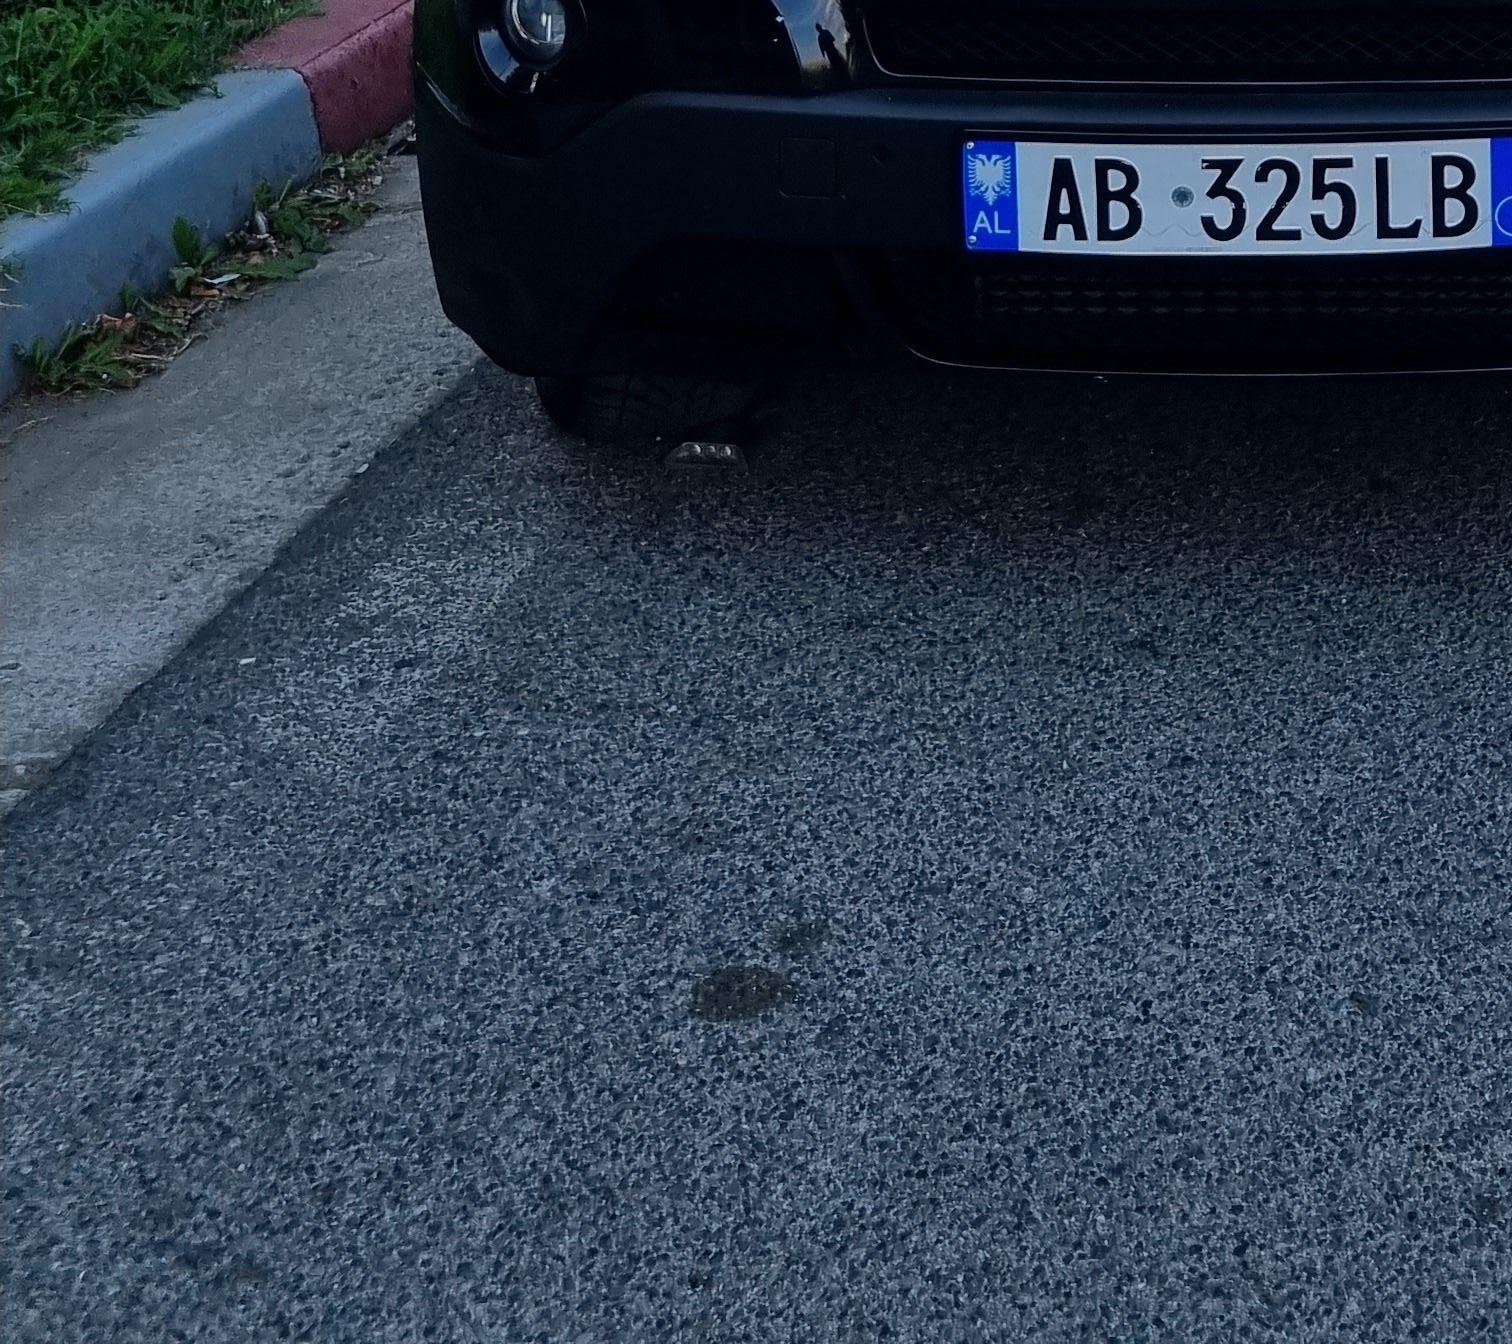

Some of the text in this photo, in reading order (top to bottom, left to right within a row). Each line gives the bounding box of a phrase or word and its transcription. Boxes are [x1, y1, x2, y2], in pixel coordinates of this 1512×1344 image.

[973, 210, 1011, 234] AL
[1042, 154, 1480, 242] AB 325LB
